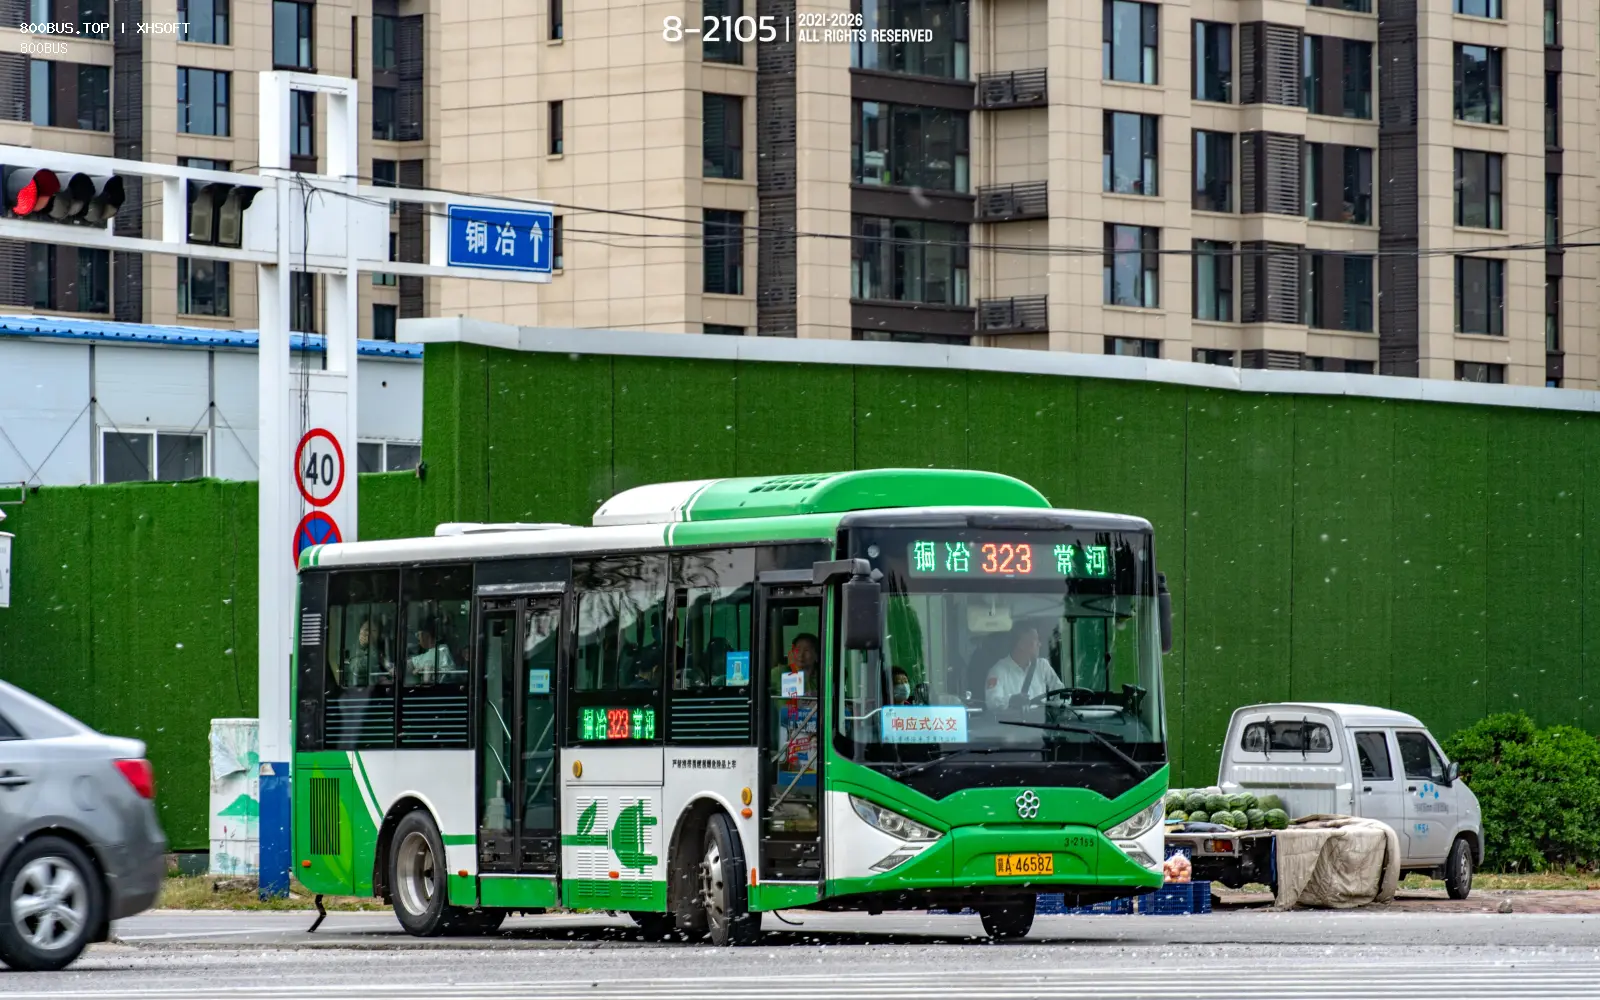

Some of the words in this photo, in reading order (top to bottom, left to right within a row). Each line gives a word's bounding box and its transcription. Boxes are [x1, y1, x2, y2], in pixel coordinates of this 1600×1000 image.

[466, 220, 517, 256] 铜冶
[305, 452, 334, 486] 40
[914, 541, 970, 572] 铜冶
[981, 543, 1032, 574] 323
[1054, 544, 1107, 576] 常河
[607, 710, 628, 738] 323
[891, 717, 958, 731] 响应式公交
